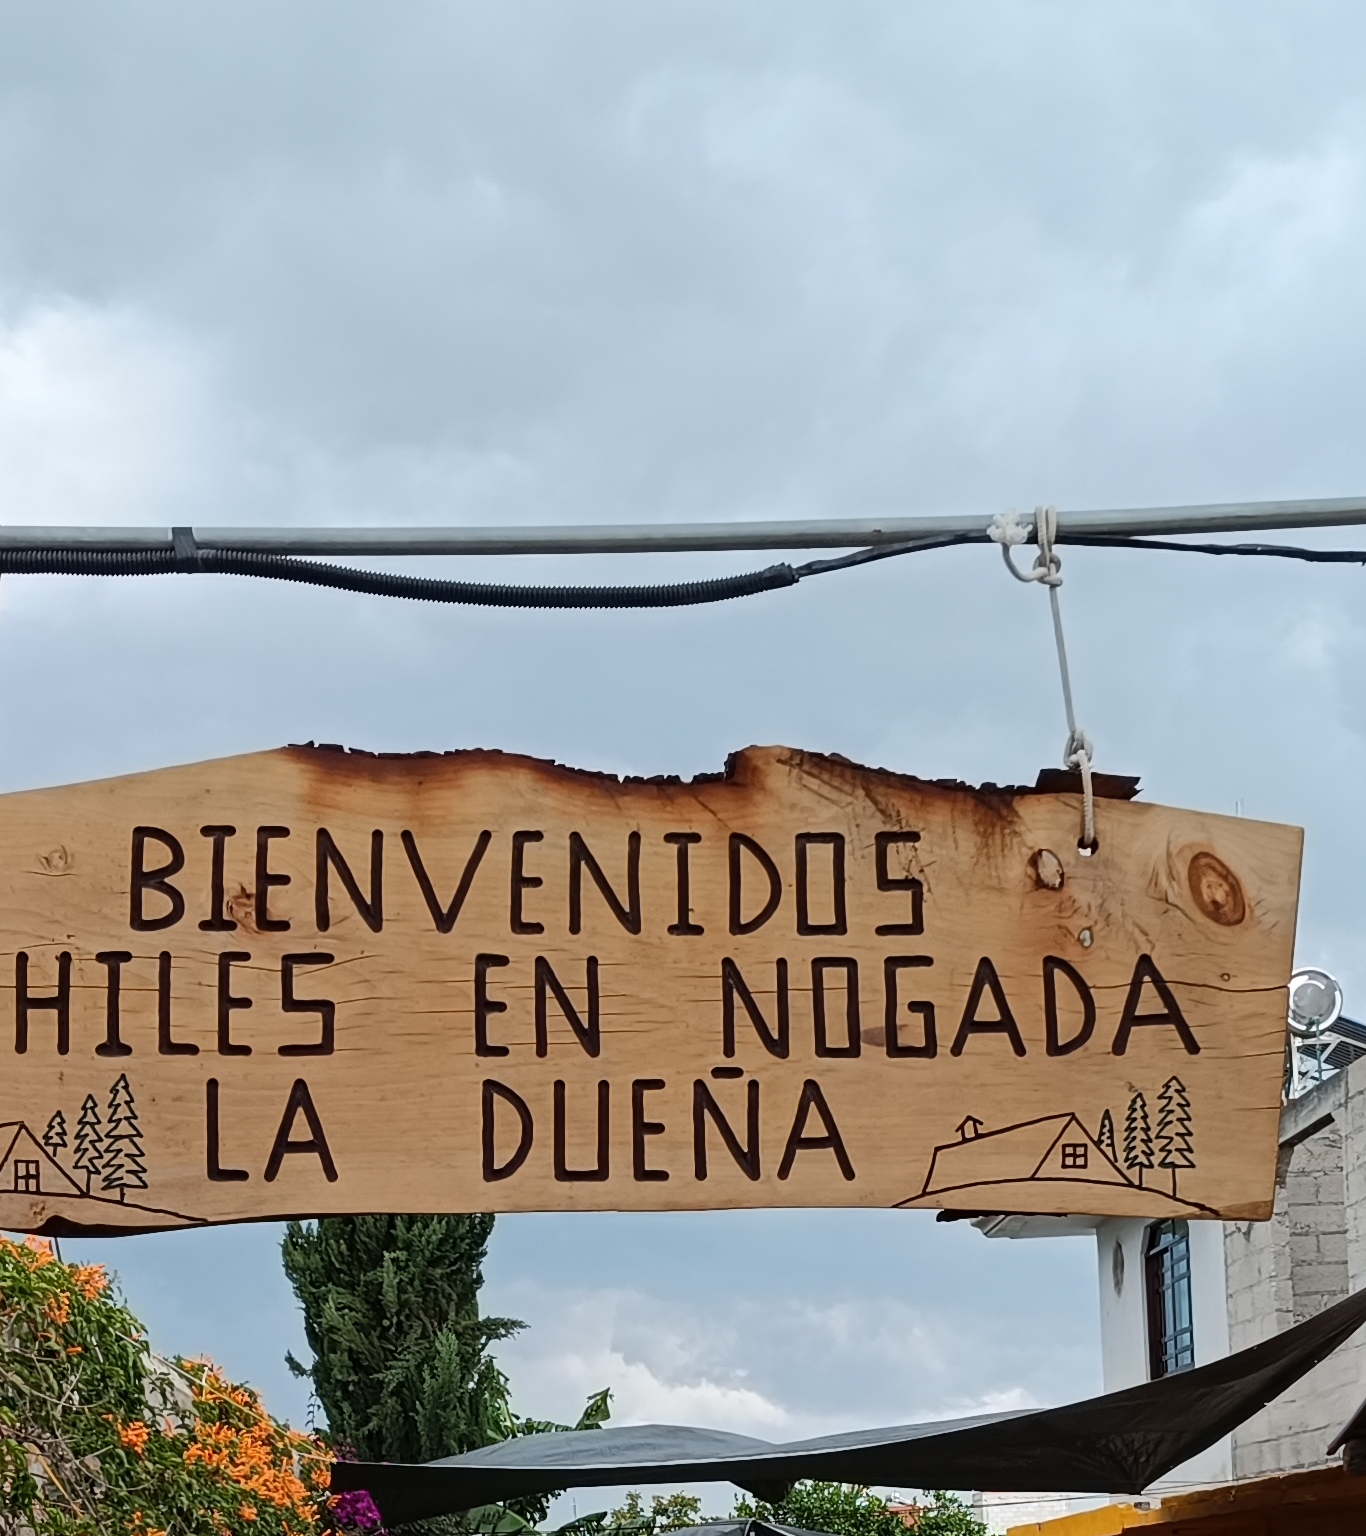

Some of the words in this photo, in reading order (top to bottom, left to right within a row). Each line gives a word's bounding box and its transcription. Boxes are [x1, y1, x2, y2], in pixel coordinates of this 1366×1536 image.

[129, 824, 925, 936] BIENVENIDOS
[474, 952, 600, 1059] EN
[721, 954, 1201, 1060] NOGADA
[206, 1077, 339, 1183] LA
[481, 1066, 856, 1183] DUEÑA
